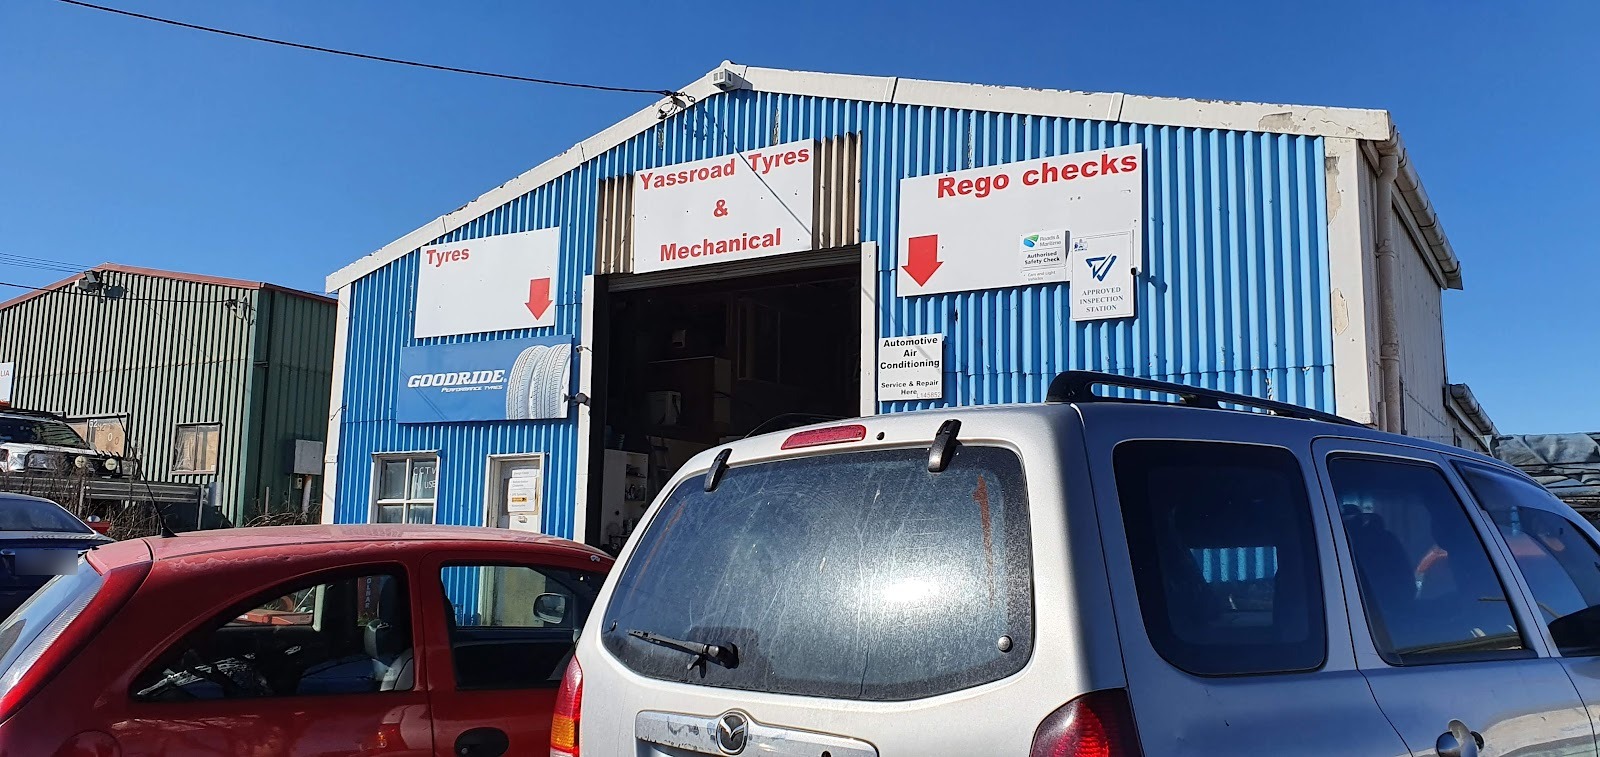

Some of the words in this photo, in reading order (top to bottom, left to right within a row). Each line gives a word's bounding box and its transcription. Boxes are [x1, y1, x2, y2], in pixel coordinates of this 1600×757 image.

[640, 158, 735, 190] Yassroad
[748, 148, 810, 174] Tyres
[937, 173, 1010, 199] Rego
[1022, 153, 1138, 186] checks
[713, 199, 728, 217] &
[660, 228, 781, 261] Mechanical
[426, 247, 470, 267] Tyres
[1027, 251, 1057, 259] Authorised
[1082, 286, 1121, 296] APPROVED
[1080, 295, 1123, 305] INSPECTION
[1086, 304, 1117, 313] STATION
[883, 337, 938, 347] Automotive
[903, 349, 917, 357] Air
[880, 359, 940, 369] Conditioning
[407, 369, 506, 388] GOODRIDE
[413, 466, 437, 476] CCTV
